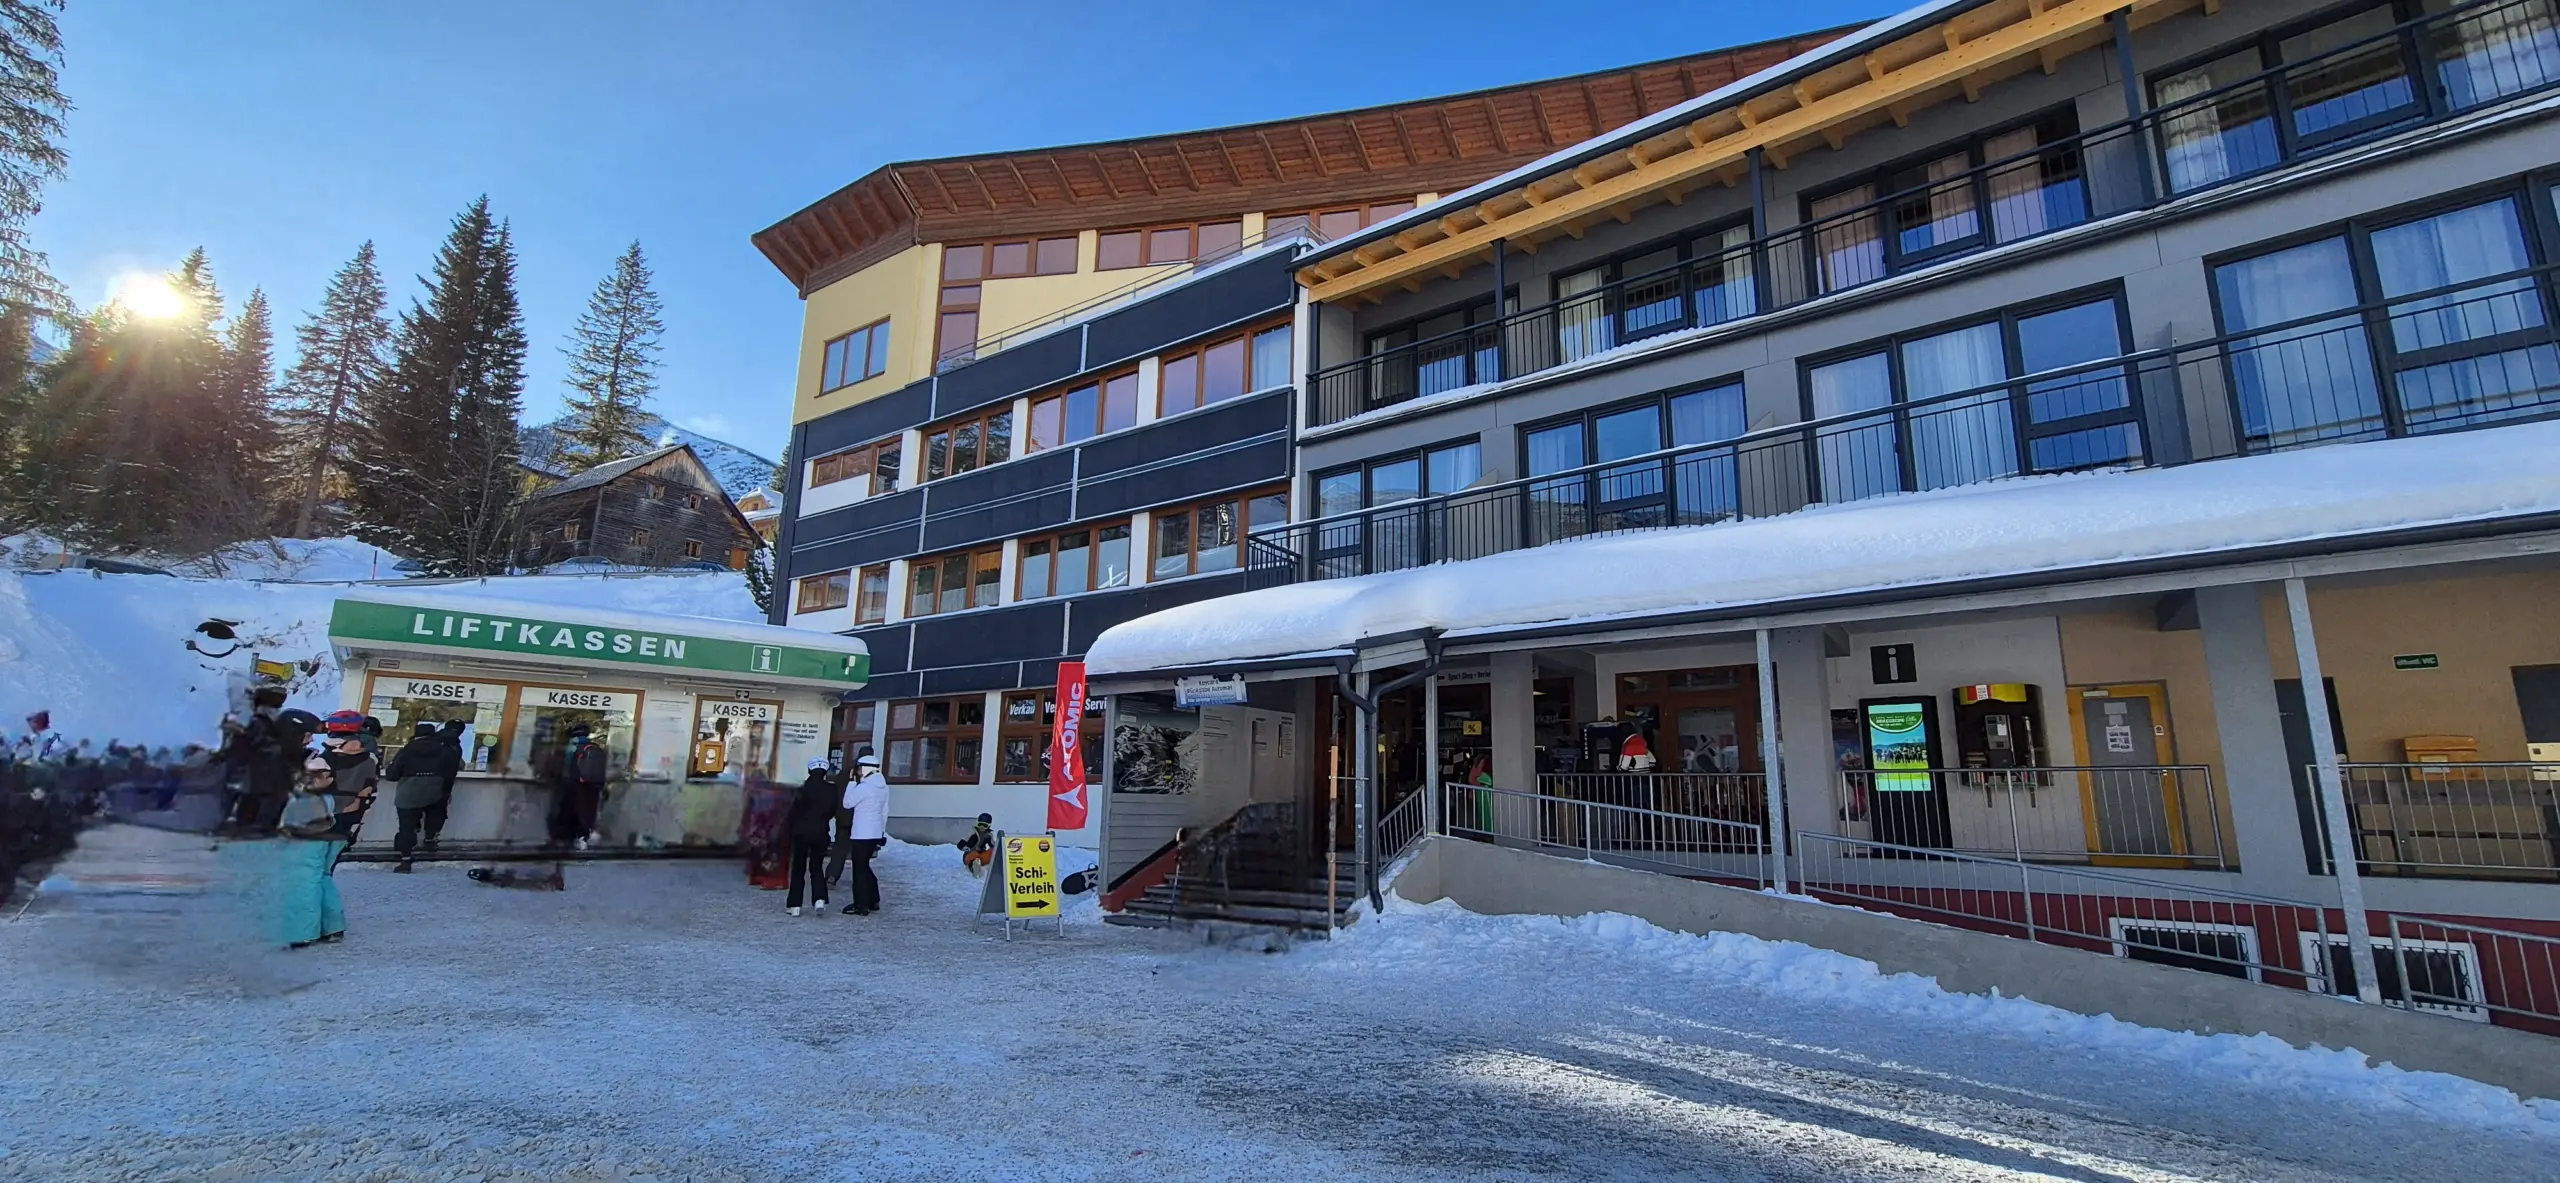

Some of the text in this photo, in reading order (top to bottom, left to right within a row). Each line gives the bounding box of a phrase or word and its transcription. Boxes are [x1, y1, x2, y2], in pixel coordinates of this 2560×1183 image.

[413, 613, 686, 659] LIFTKASSEN
[406, 682, 476, 698] KASSE 1
[548, 691, 612, 707] KASSE 2
[1084, 697, 1108, 711] Servi
[712, 704, 767, 718] KASSE 3
[1009, 703, 1036, 716] Verkau
[1015, 866, 1047, 879] Schi-
[1009, 881, 1055, 895] Verleih
